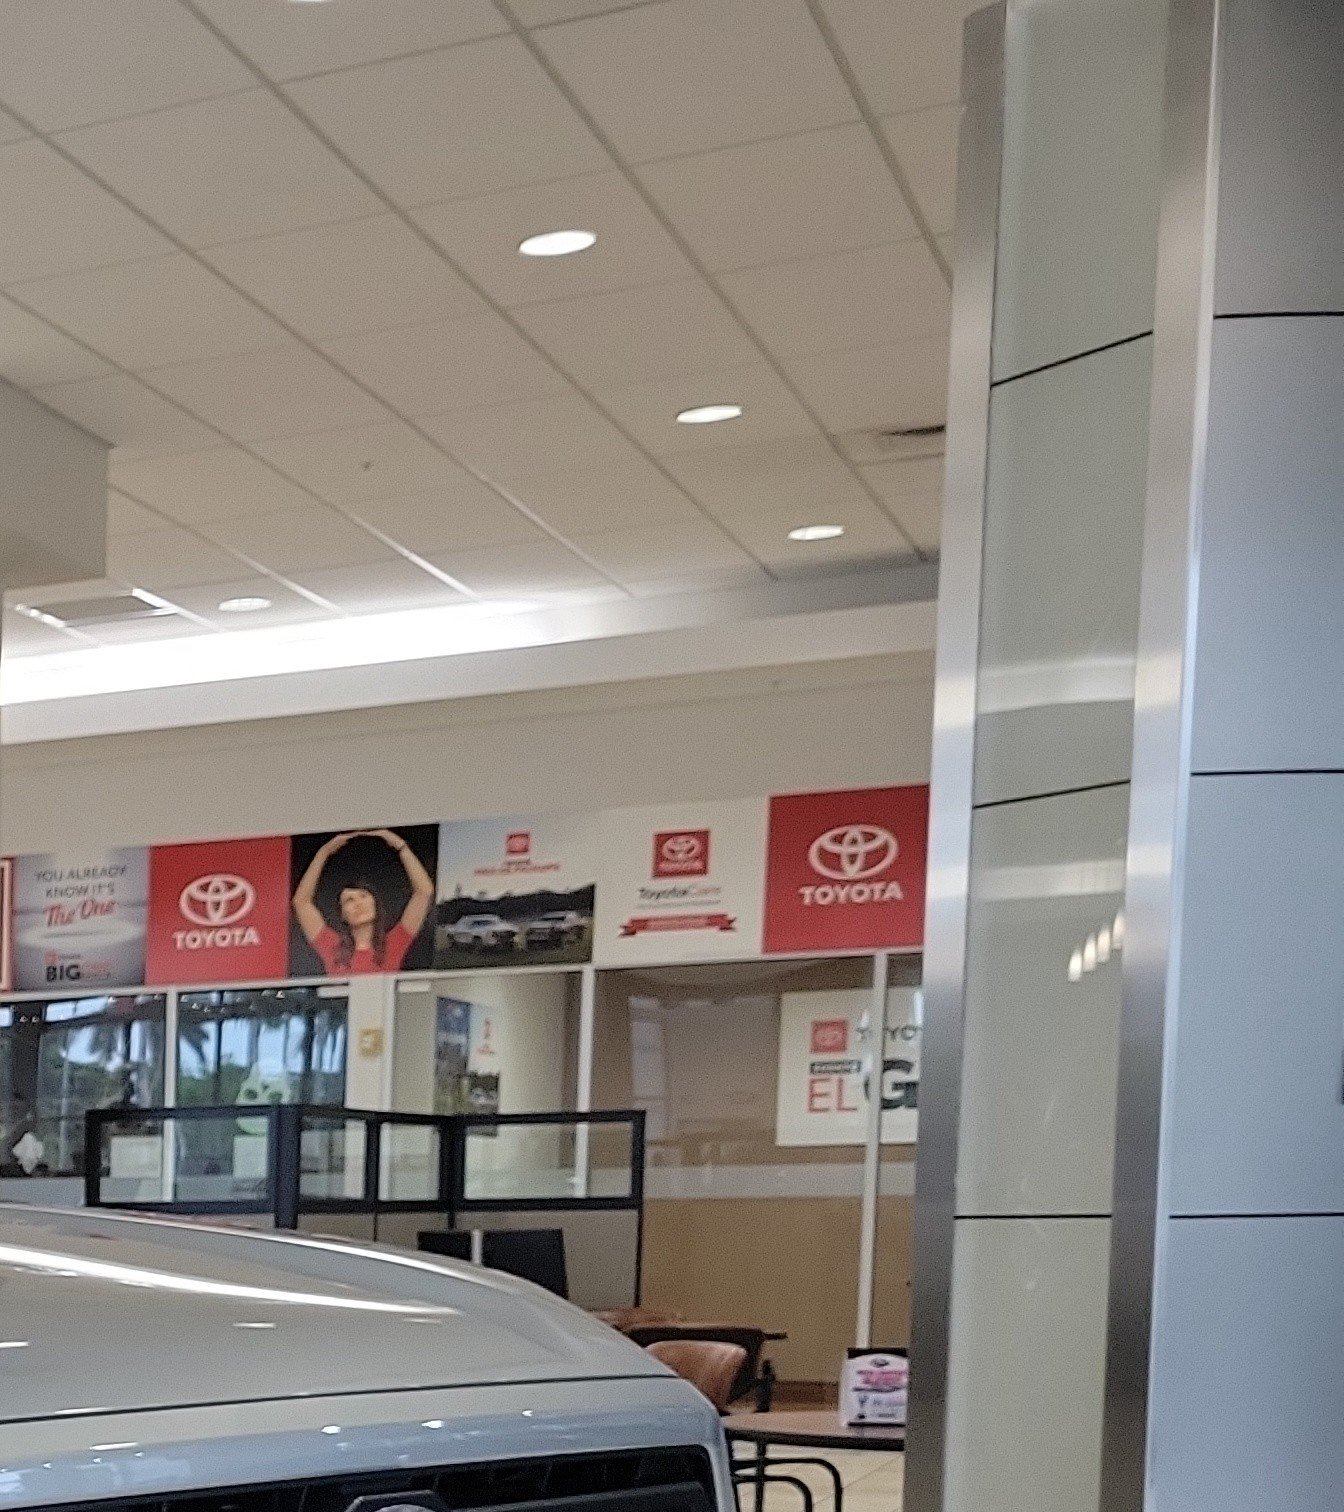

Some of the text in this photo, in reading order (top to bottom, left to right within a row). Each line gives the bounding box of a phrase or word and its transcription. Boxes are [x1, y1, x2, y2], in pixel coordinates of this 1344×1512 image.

[34, 865, 127, 882] YOU ALREADY
[46, 884, 89, 898] KNOW
[798, 880, 904, 906] TOYOTA
[80, 898, 117, 920] One
[172, 927, 260, 950] TOYOTA
[46, 964, 81, 983] BIG
[809, 1077, 858, 1113] EL
